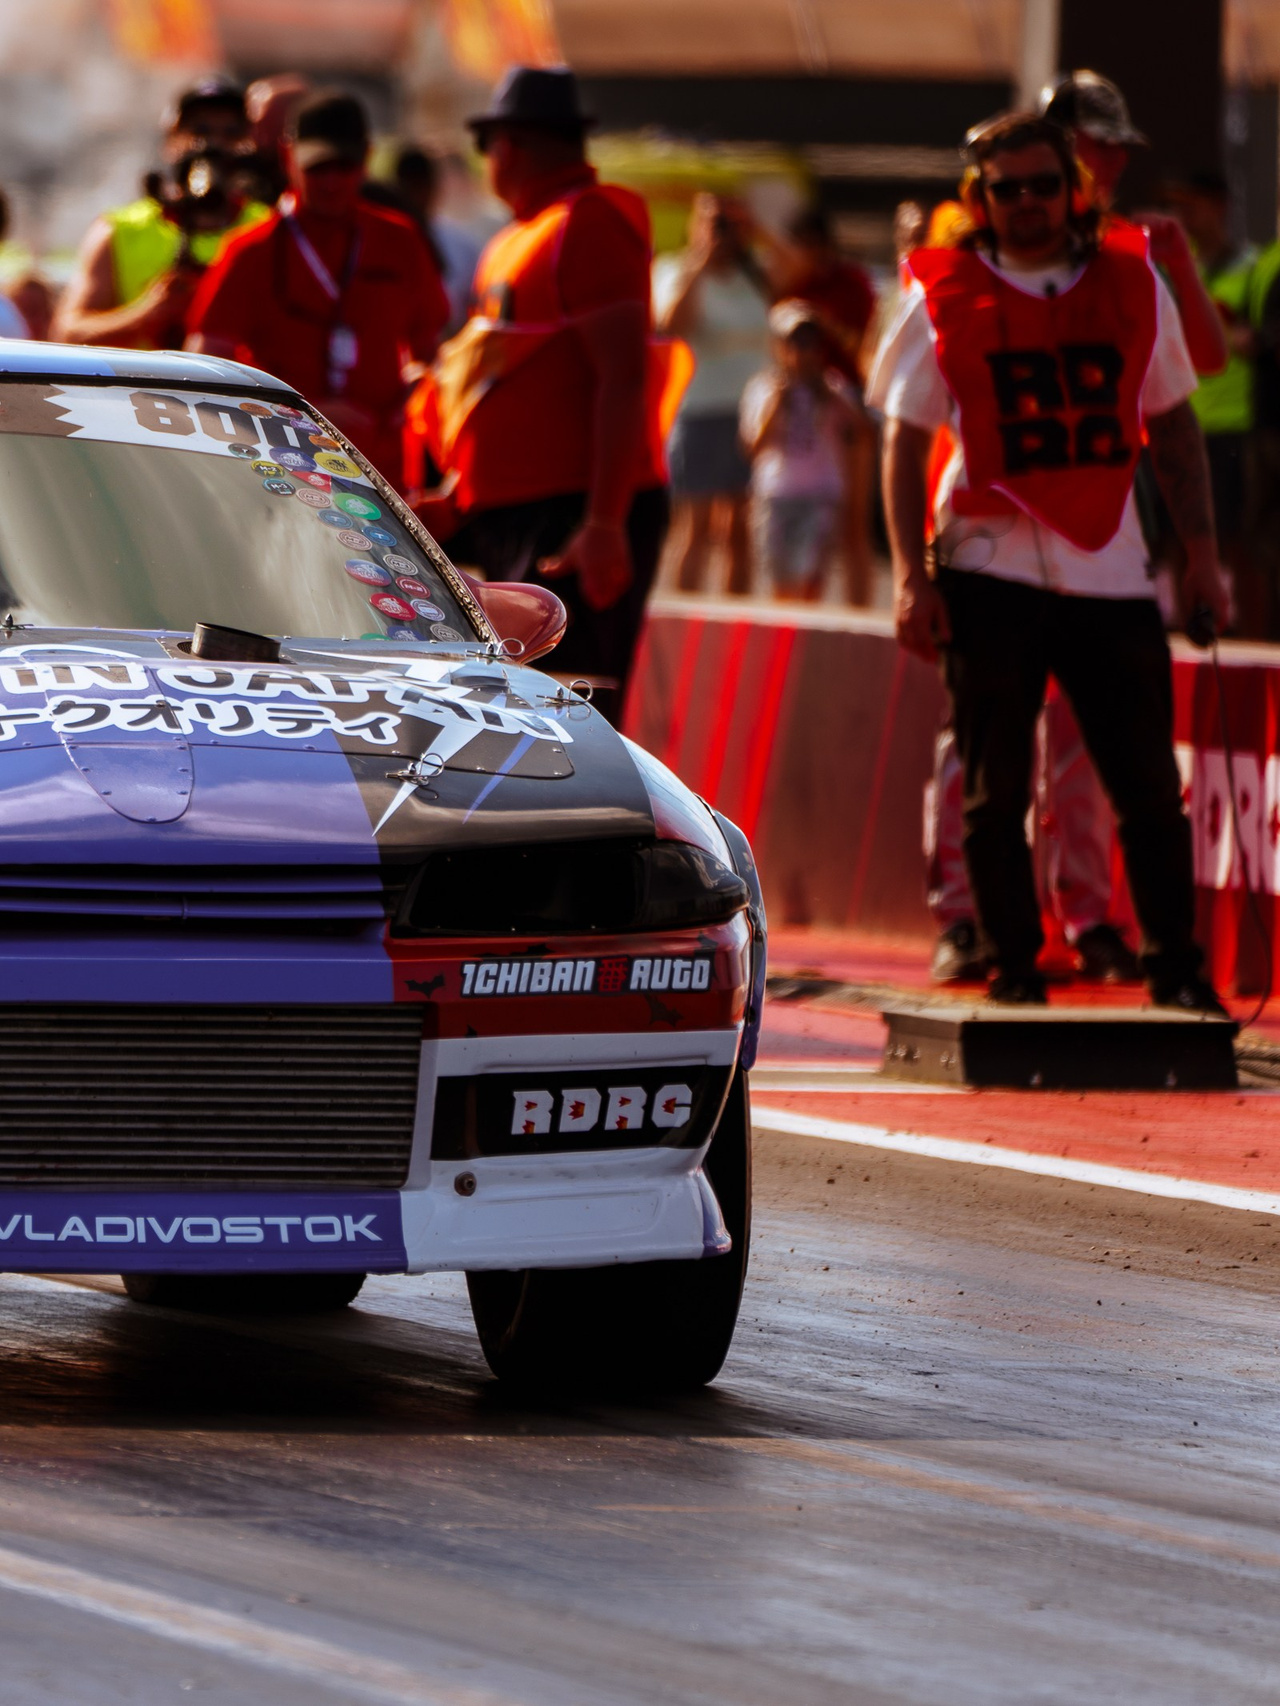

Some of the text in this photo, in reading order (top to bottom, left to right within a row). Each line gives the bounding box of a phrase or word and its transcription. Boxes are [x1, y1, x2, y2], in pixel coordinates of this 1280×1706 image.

[462, 960, 596, 995] ICHIBAN
[630, 959, 711, 990] AUTO
[511, 1084, 693, 1135] RDRC
